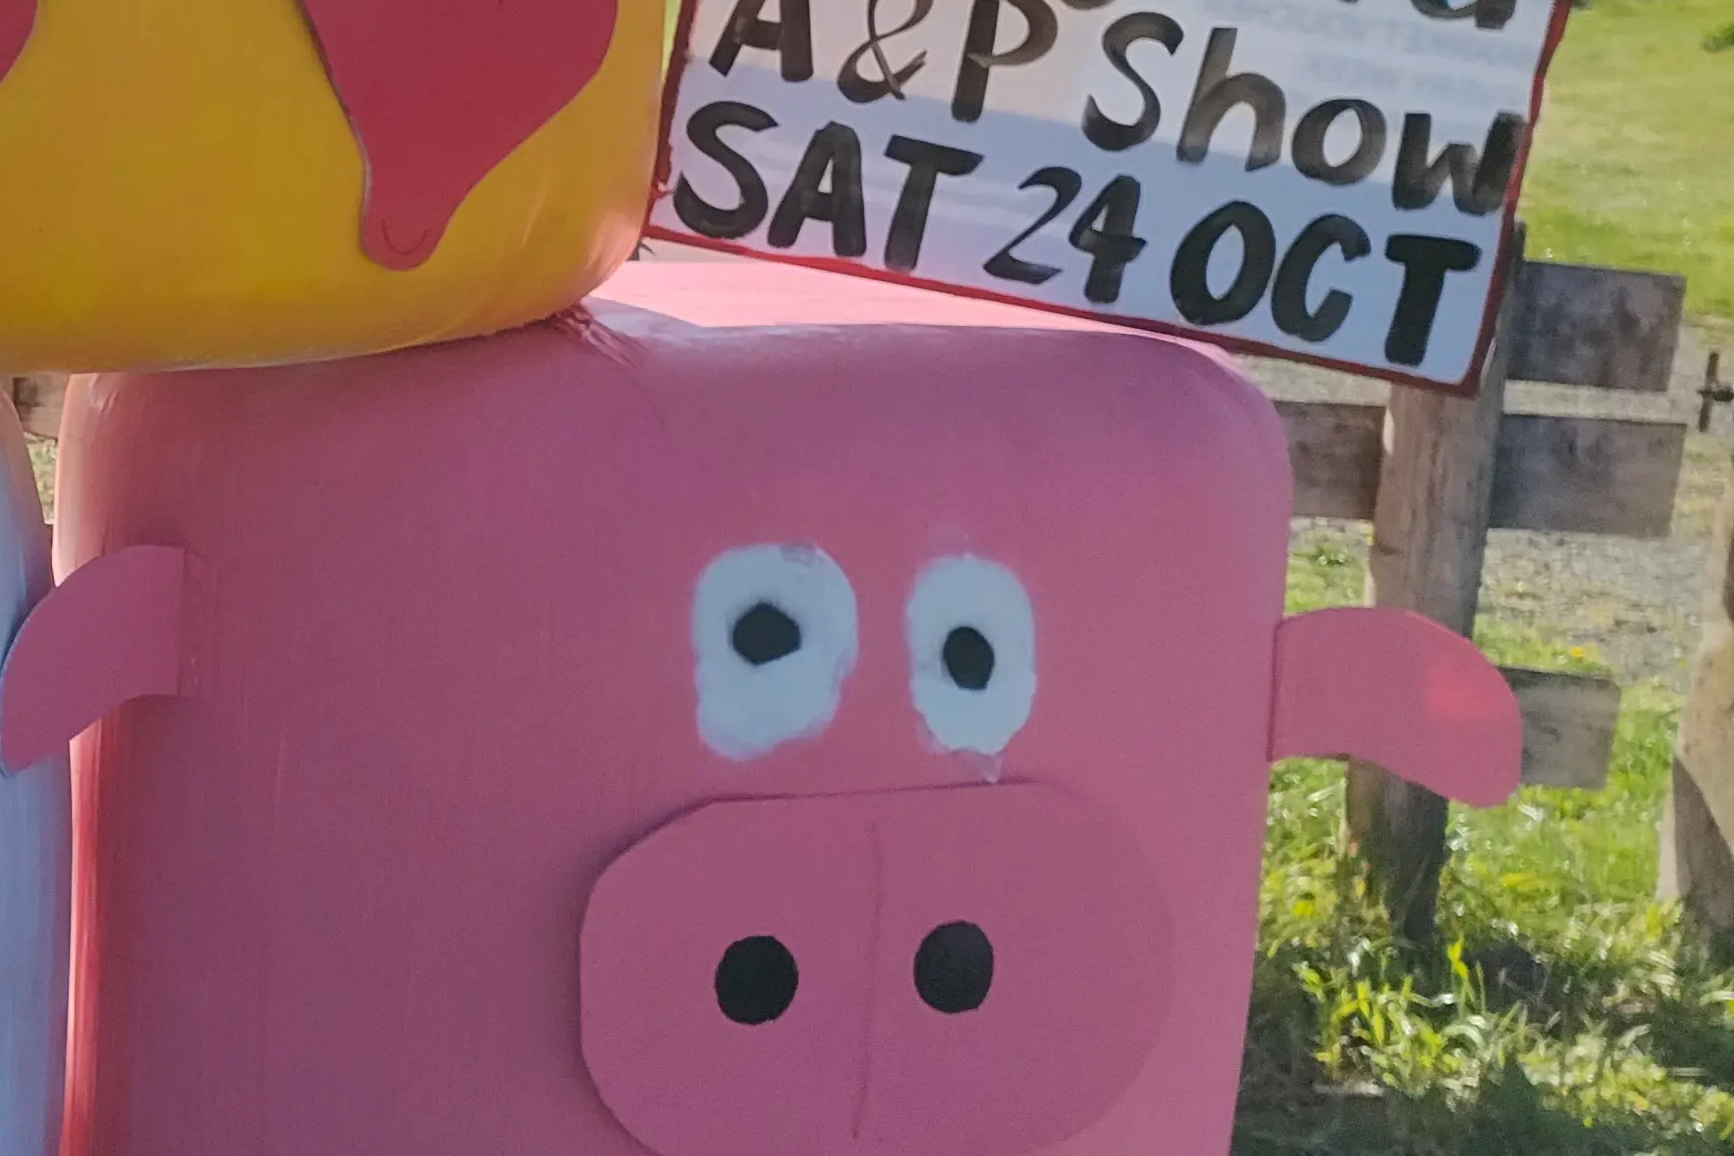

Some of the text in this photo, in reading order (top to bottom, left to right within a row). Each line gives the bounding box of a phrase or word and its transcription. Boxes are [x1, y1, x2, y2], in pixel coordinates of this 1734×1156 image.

[1081, 11, 1527, 217] Show
[673, 100, 1482, 367] SAT 24 OCT
